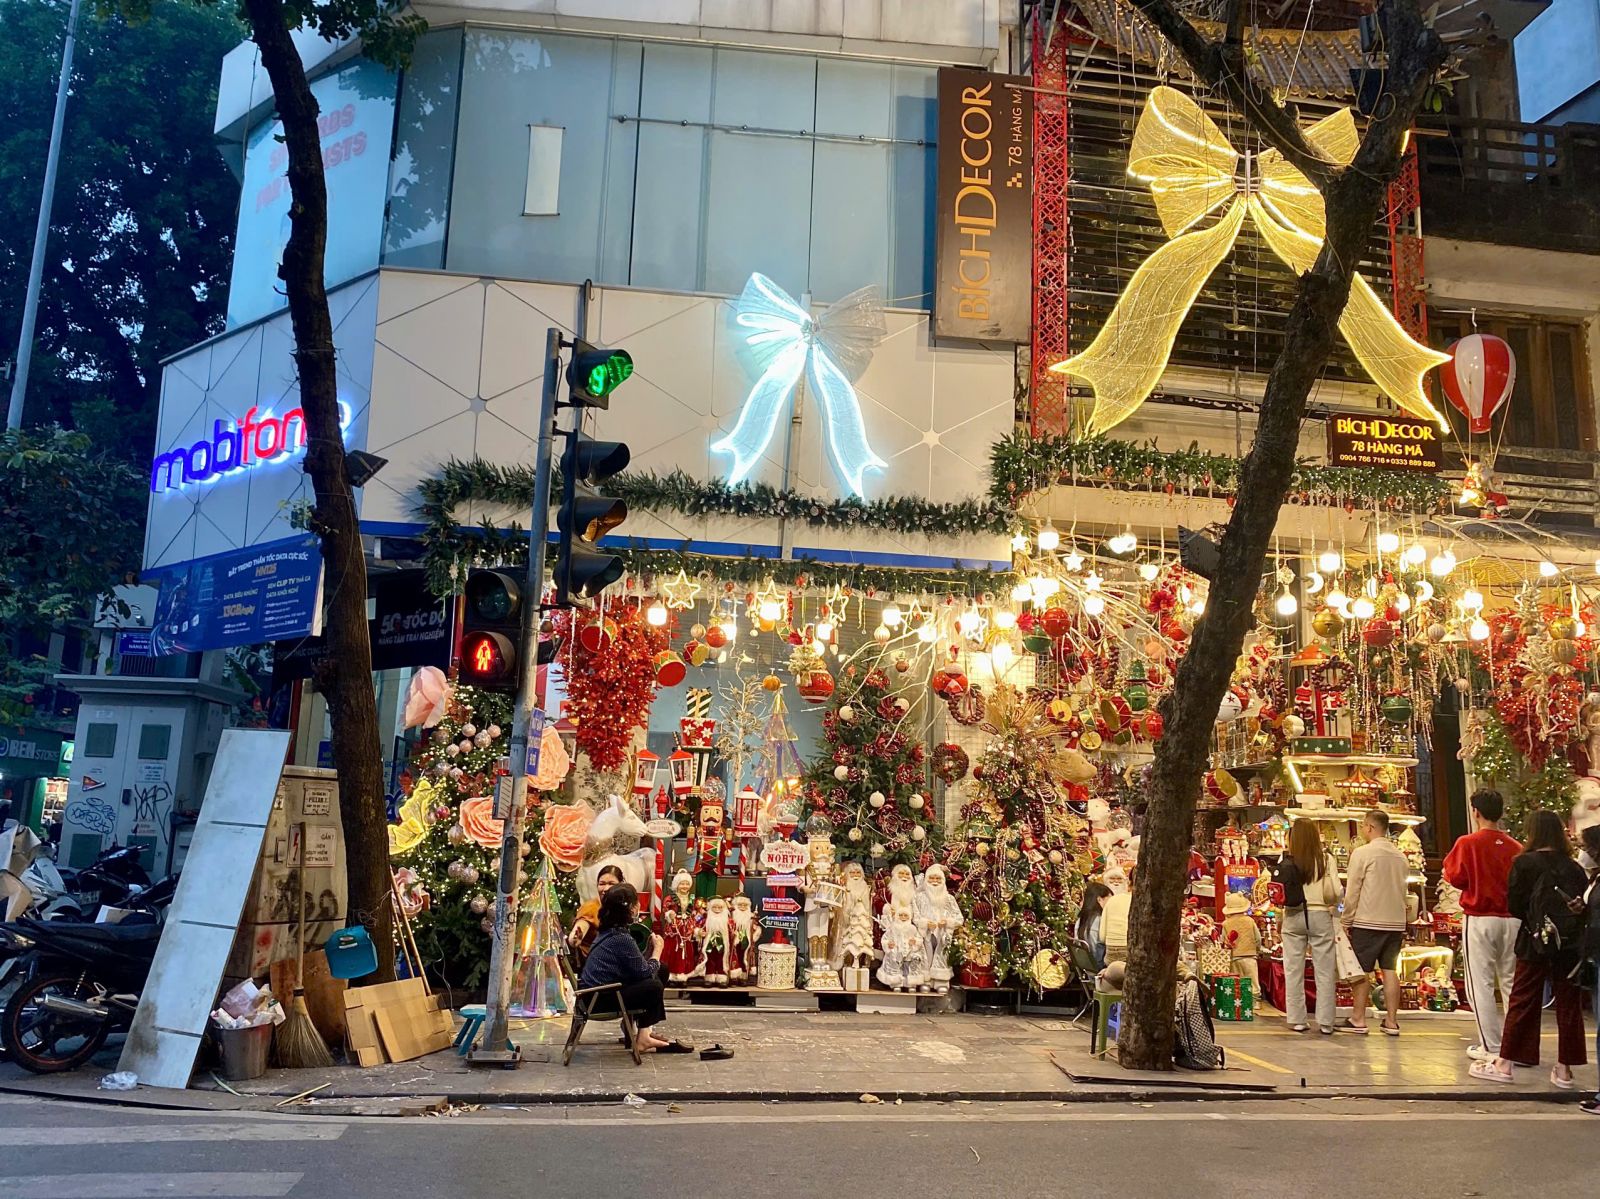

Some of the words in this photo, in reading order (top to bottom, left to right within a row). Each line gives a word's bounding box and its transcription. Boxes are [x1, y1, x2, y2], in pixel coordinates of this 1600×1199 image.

[1010, 107, 1022, 142] HÀNG
[1008, 146, 1022, 167] 78
[952, 81, 997, 320] BÍCHDECOR
[1337, 417, 1436, 440] BÍCHDECOR
[1351, 440, 1365, 452] 78
[1367, 440, 1403, 455] HÀNG
[1404, 444, 1424, 456] MÃ
[767, 854, 804, 864] NORTH
